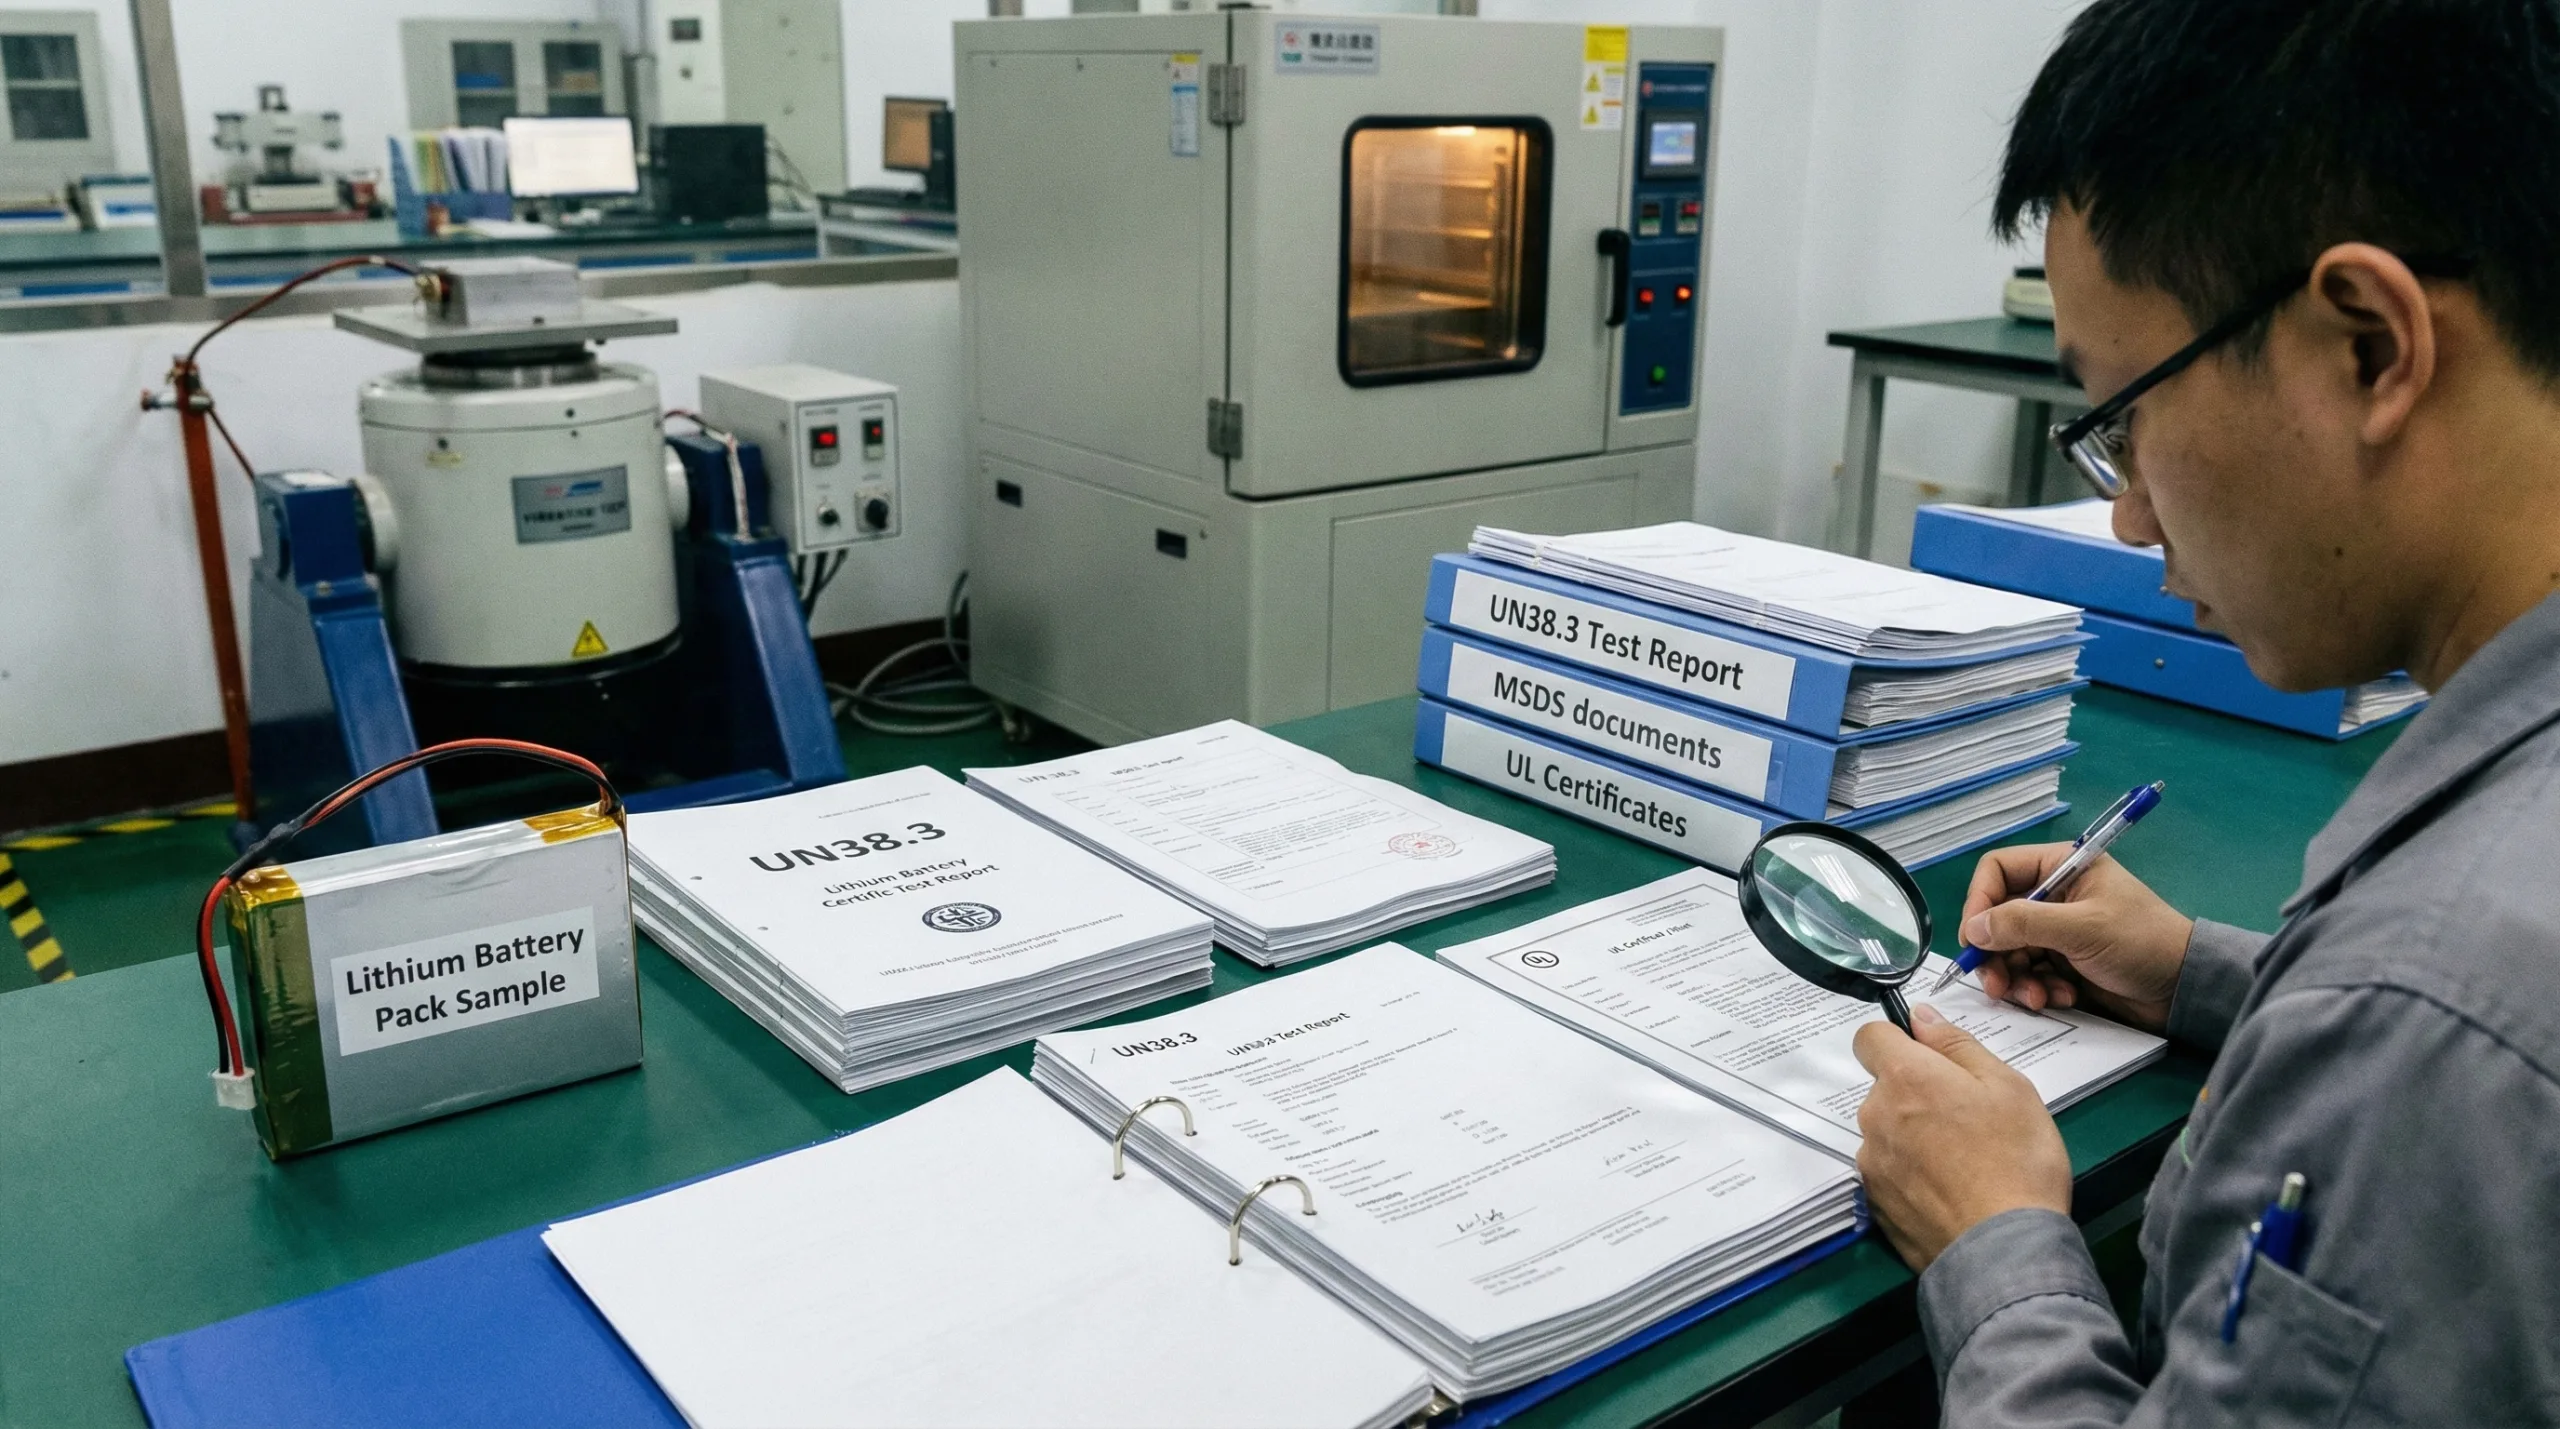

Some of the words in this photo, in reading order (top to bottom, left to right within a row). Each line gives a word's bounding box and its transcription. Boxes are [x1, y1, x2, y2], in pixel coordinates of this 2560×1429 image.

[1491, 595, 1579, 643] UN38.3
[1589, 620, 1642, 662] Test
[1649, 639, 1744, 691] Report
[1495, 672, 1566, 718] MSDS
[1573, 699, 1721, 769] documents
[1507, 750, 1536, 785] UL
[1544, 765, 1688, 838] Certificates
[750, 823, 946, 873] UN38.3
[824, 875, 897, 894] Lithium
[899, 857, 968, 879] Battery
[895, 879, 935, 894] Test
[935, 864, 1000, 886] Report
[346, 954, 465, 996] Lithium
[475, 928, 584, 969] Battery
[376, 994, 449, 1033] Pack
[457, 970, 566, 1014] Sample
[1304, 1012, 1351, 1031] Report
[1112, 1032, 1198, 1057] UN38.3
